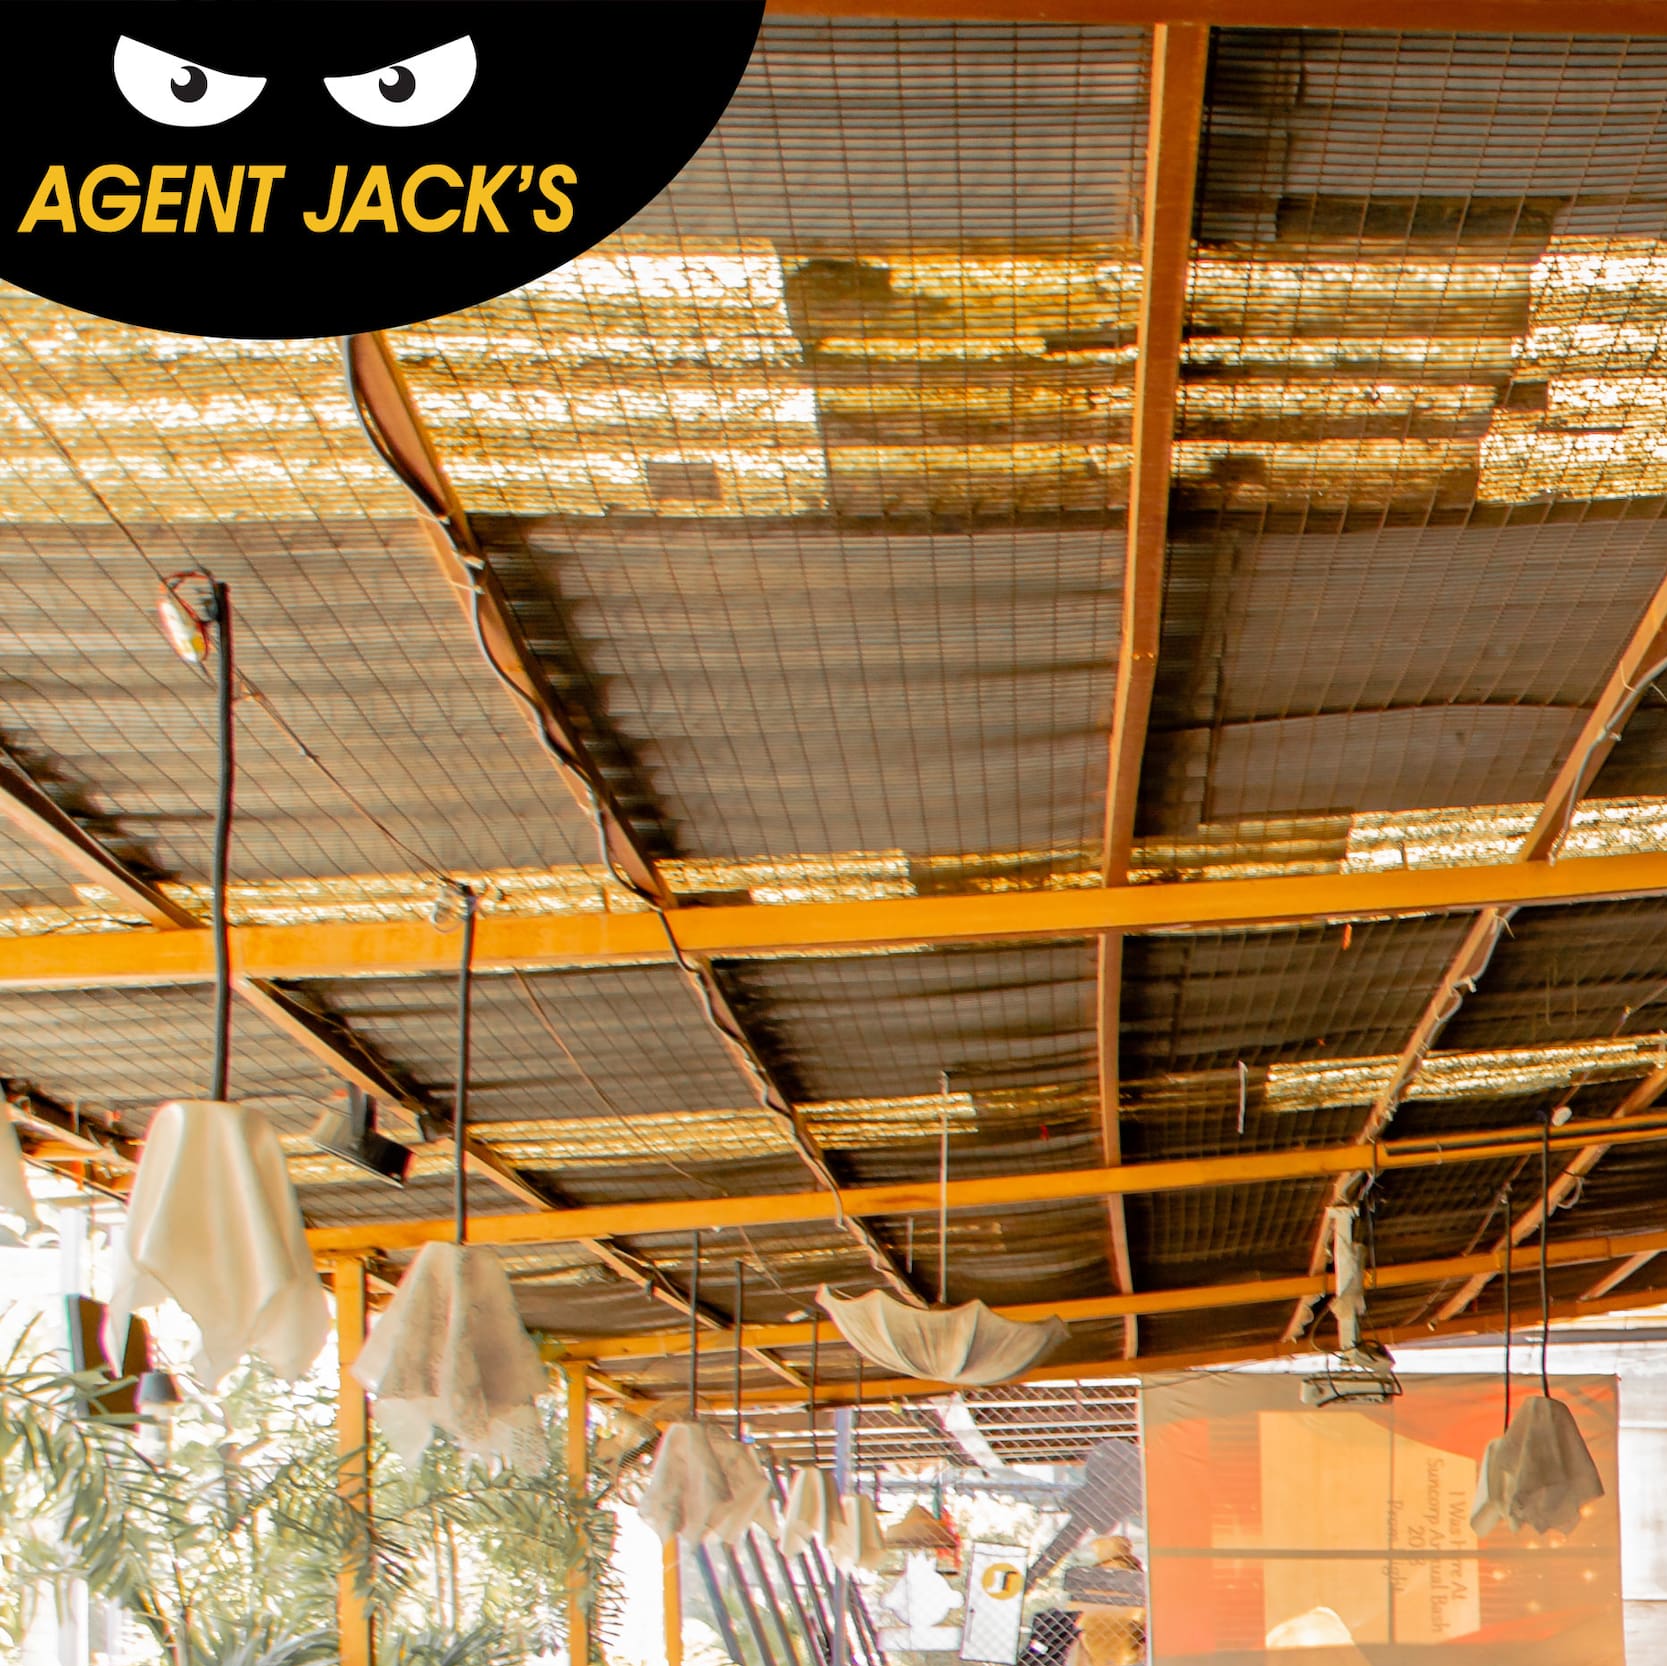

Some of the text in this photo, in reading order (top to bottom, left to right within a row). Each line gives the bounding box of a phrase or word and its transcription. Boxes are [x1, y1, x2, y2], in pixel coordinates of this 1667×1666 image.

[1424, 1457, 1445, 1525] Suncorp
[1448, 1501, 1466, 1535] Was
[1450, 1539, 1467, 1578] Hre
[1432, 1595, 1450, 1633] Bash
